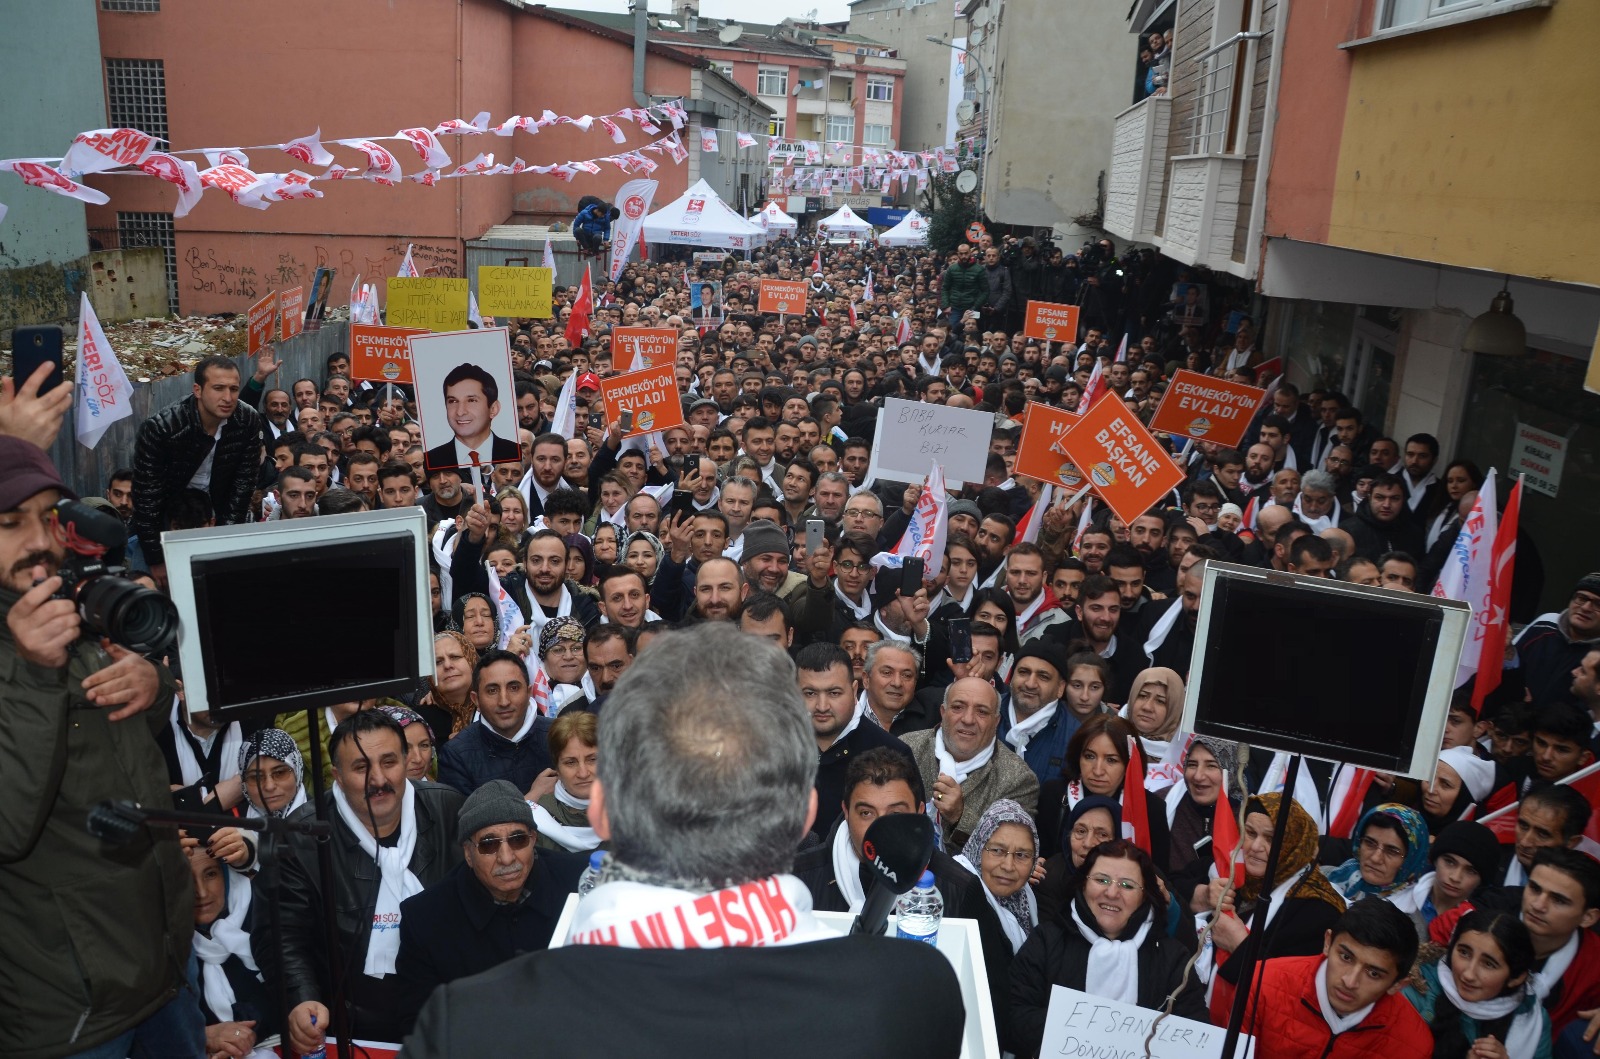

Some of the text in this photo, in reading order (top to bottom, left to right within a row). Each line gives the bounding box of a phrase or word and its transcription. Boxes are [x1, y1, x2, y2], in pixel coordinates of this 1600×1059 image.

[614, 230, 628, 257] SÖZ
[768, 292, 799, 301] EVLADI
[1036, 316, 1068, 327] BAŞKAN
[1037, 307, 1069, 318] EFSANE
[355, 335, 409, 347] ÇEKMEKÖY
[366, 346, 411, 360] EVLAD
[94, 373, 117, 409] SÖZ
[606, 375, 673, 402] ÇEKMEKÖY'ÜN
[618, 390, 666, 410] EVLADI
[1174, 381, 1256, 410] ÇEKMEKÖY'ÜN
[1179, 396, 1239, 420] EVLADI
[1095, 427, 1147, 488] BAŞKAN
[1109, 417, 1160, 476] EFSANE
[382, 912, 399, 923] SÖZ
[630, 875, 797, 949] HÜSEYİN
